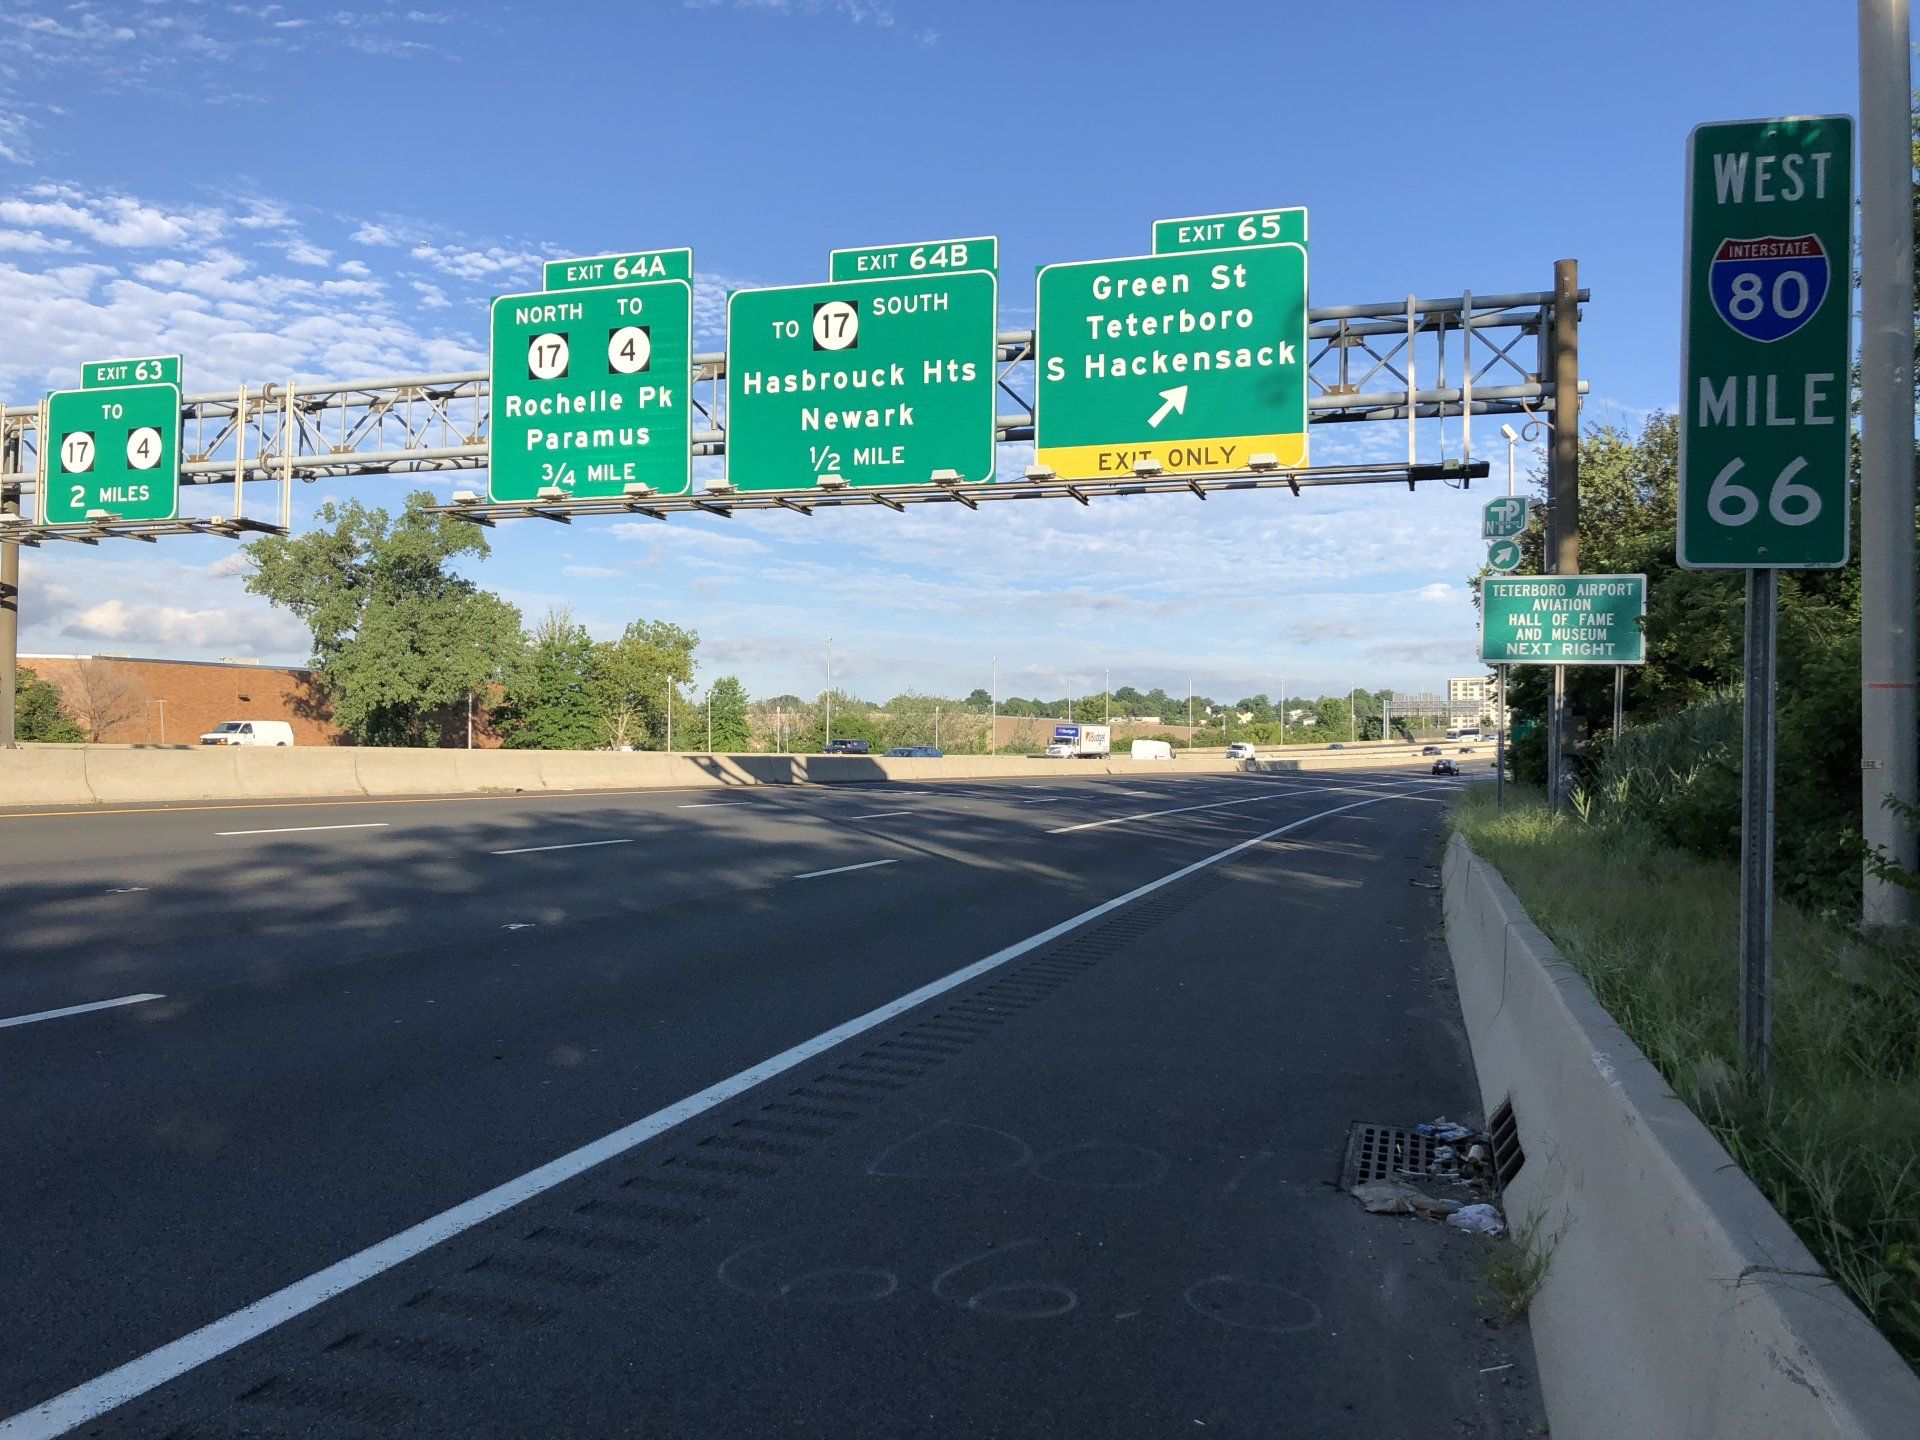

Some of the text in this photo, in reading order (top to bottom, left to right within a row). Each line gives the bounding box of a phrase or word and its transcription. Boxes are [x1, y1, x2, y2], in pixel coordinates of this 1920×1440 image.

[1714, 152, 1831, 204] WEST
[1179, 215, 1280, 243] EXIT 65
[858, 244, 967, 271] EXIT 64B
[1729, 242, 1809, 257] INTERSTATE
[568, 256, 666, 281] EXIT 64A
[1093, 264, 1245, 299] Green St
[1729, 271, 1808, 320] 80
[516, 298, 642, 324] NORTH TO
[773, 293, 947, 338] TO 17 SOUTH
[1087, 309, 1253, 339] Teterboro
[538, 344, 560, 368] 17
[620, 338, 635, 361] 4
[1047, 341, 1295, 381] S Hackensack
[98, 361, 162, 380] EXIT 63
[745, 359, 975, 394] Hasbrouck Hts
[102, 404, 122, 419] TO
[506, 386, 672, 417] Rochelle Pk
[1699, 373, 1834, 427] MILE
[802, 403, 913, 430] Newark
[137, 438, 149, 458] 4
[528, 428, 649, 450] Paramus
[69, 442, 88, 463] 17
[810, 446, 904, 471] 1/2 MILE
[1169, 446, 1236, 467] ONLY
[542, 463, 635, 486] 3/4 MILE
[71, 485, 149, 507] 2 MILES
[1708, 456, 1821, 526] 66
[1493, 583, 1633, 596] TETERBORO AIRPORT
[1533, 599, 1590, 611] AVIATION
[1509, 613, 1613, 626] HALL OF FAME
[1517, 628, 1606, 640] AND MUSEUM
[1507, 643, 1615, 655] NEXT RIGHT
